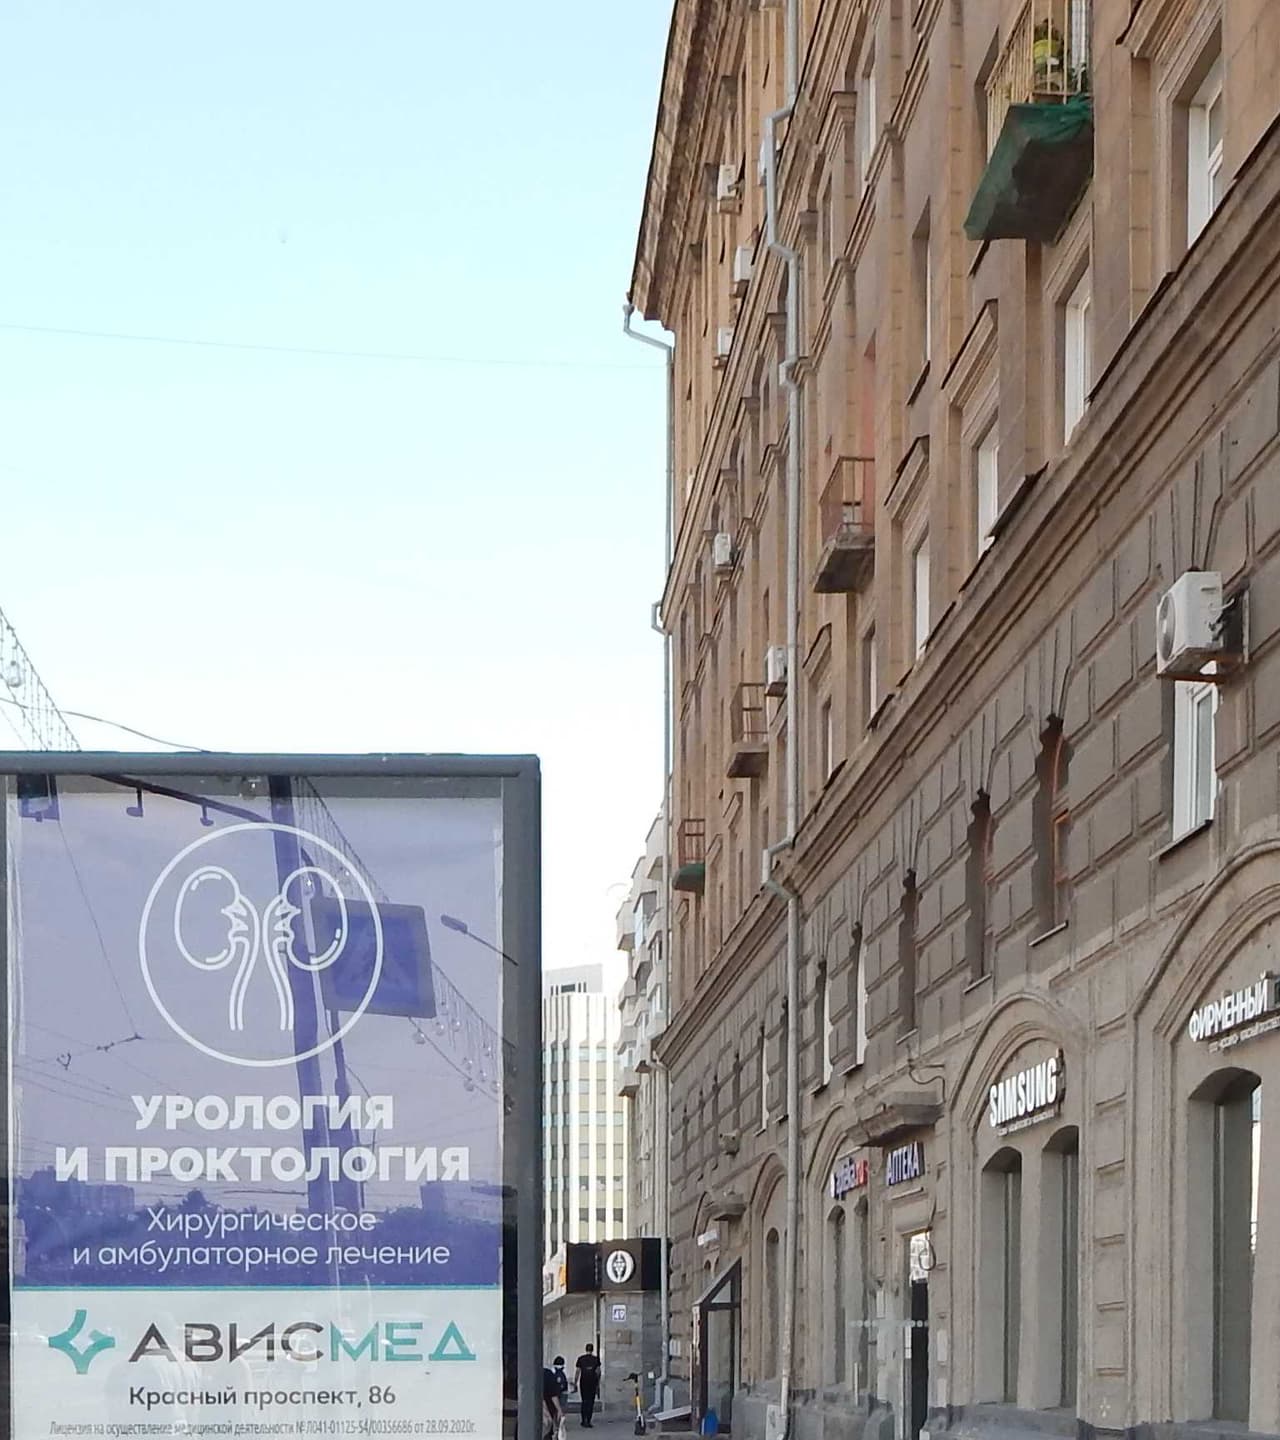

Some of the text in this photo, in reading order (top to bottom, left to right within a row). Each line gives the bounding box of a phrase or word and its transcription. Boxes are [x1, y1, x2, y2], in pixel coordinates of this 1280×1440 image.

[1188, 972, 1269, 1042] ФИРМЕННЫЙ
[990, 1057, 1057, 1128] SAMSUNG
[133, 1095, 394, 1129] УРОЛОГИЯ
[55, 1146, 470, 1181] И ПРОКТОЛОГИЯ
[886, 1141, 921, 1187] АПТЕКА
[146, 1207, 376, 1239] Хирургическое
[73, 1240, 450, 1272] и амбулаторное лечение
[128, 1320, 477, 1363] АВИСМЕД
[130, 1385, 397, 1410] Красный проспект, 86
[50, 1421, 92, 1436] Лицензия
[94, 1424, 104, 1434] на
[106, 1423, 173, 1437] осуществление
[234, 1422, 294, 1436] деятельности
[414, 1423, 424, 1434] от
